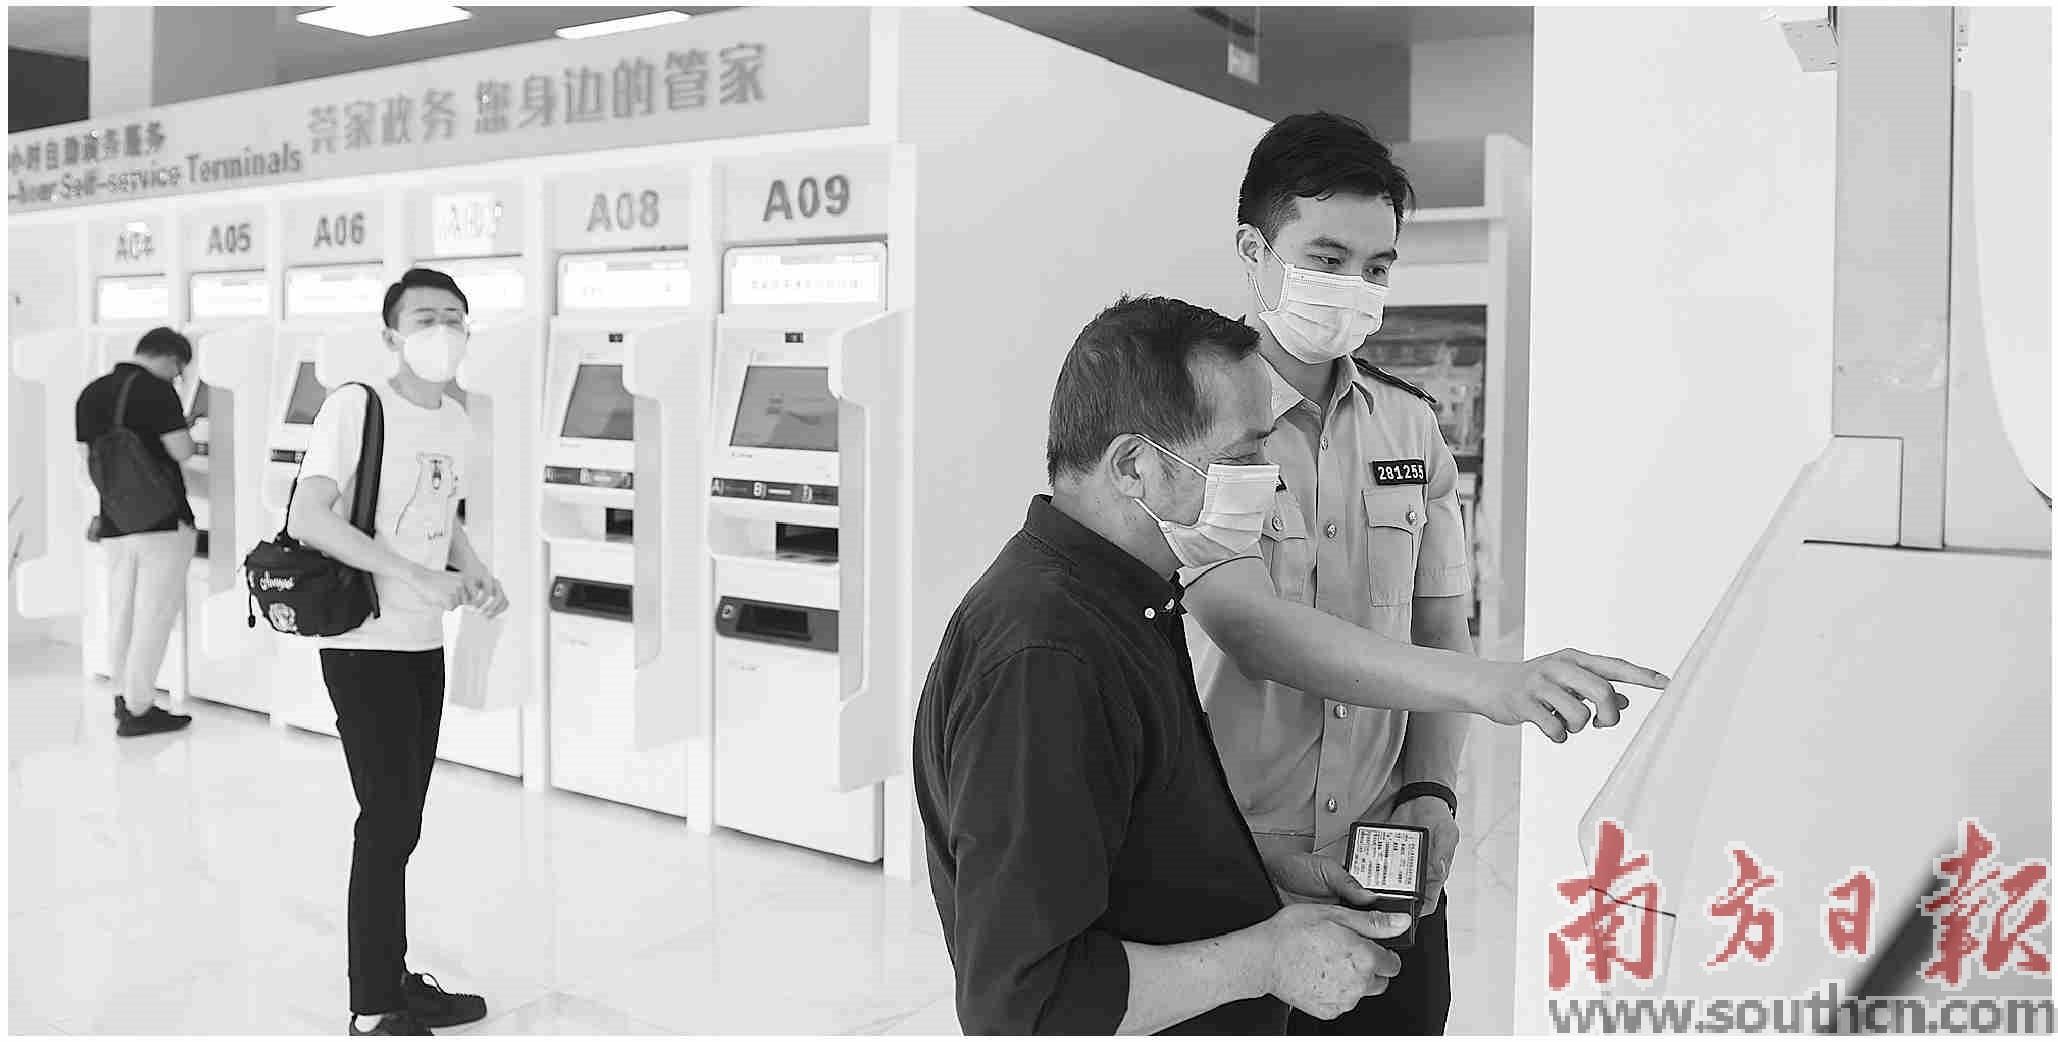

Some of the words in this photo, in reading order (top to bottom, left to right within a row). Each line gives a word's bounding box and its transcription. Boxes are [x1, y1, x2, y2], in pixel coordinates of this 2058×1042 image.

[474, 42, 767, 136] 您身边的管家
[184, 139, 305, 183] Terminals
[586, 189, 661, 232] A08
[762, 173, 852, 223] A09
[206, 222, 252, 256] A05
[313, 211, 365, 249] A06
[1377, 464, 1424, 480] 281255
